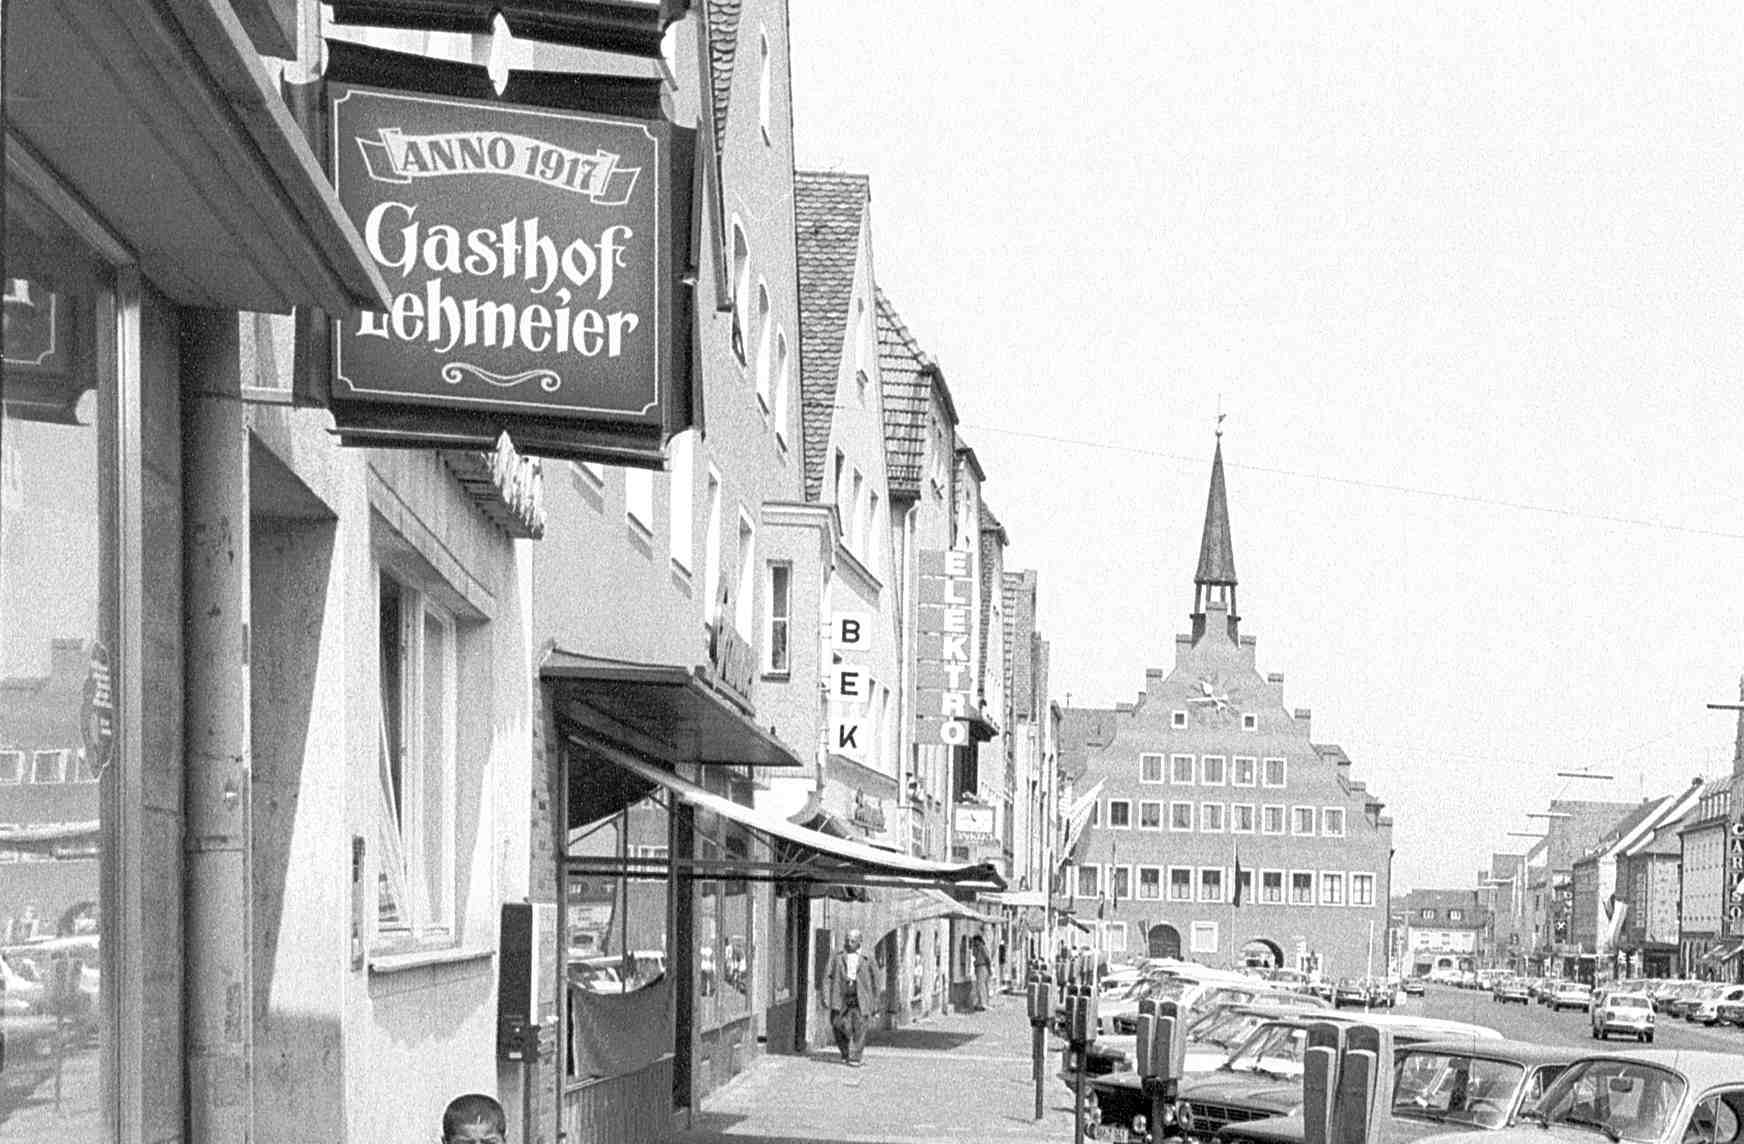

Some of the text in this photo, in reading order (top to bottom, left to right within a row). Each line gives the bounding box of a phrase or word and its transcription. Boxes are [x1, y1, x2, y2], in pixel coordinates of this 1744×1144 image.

[402, 136, 600, 191] ANNO 1917
[365, 202, 633, 300] Gasthof
[838, 619, 862, 750] BEK
[941, 551, 969, 746] ELEKTRO
